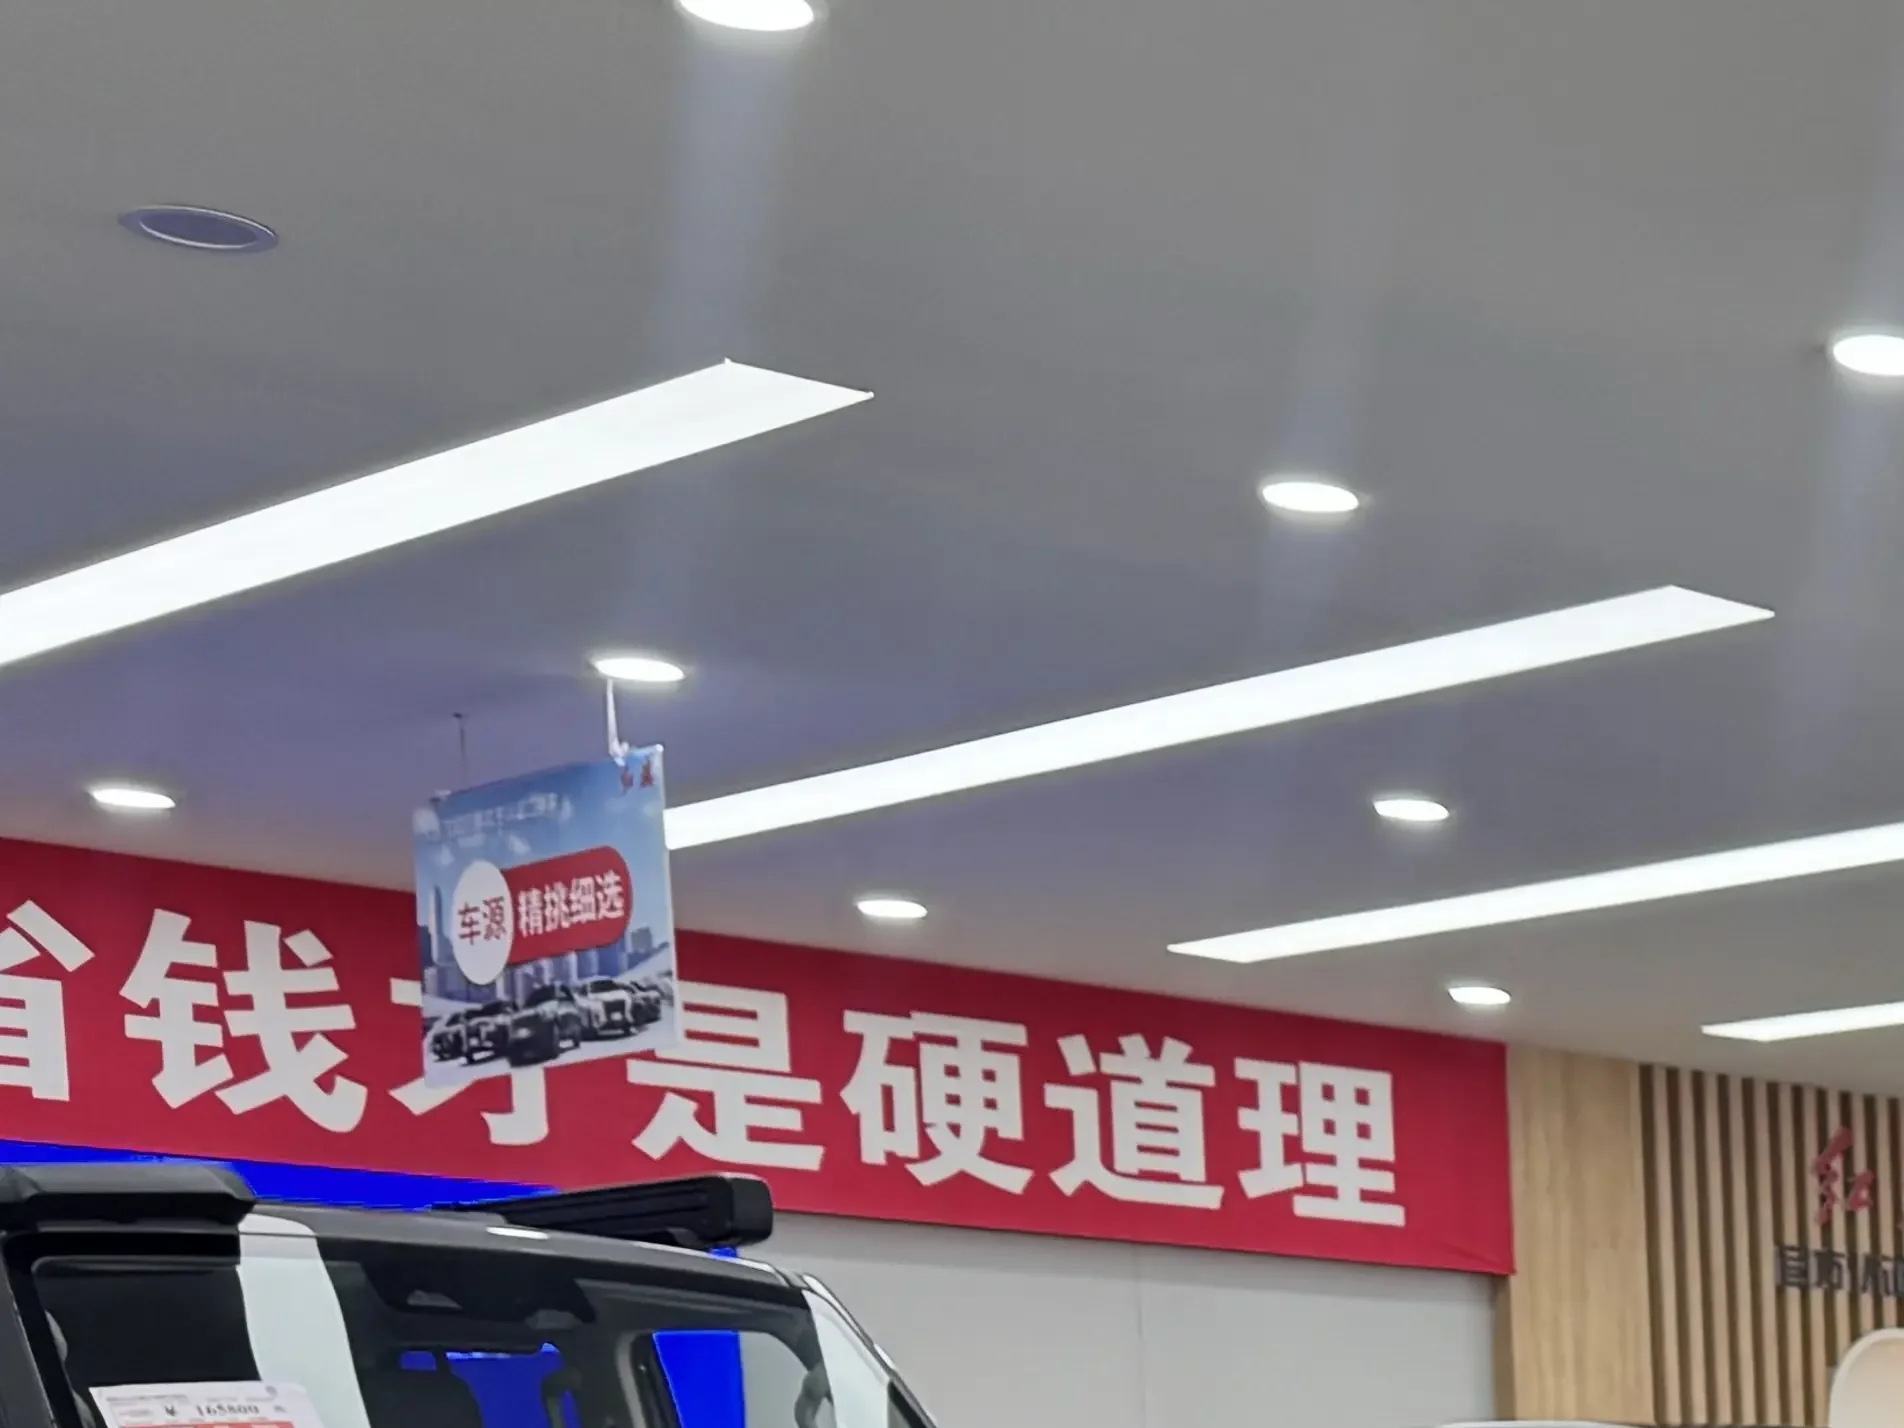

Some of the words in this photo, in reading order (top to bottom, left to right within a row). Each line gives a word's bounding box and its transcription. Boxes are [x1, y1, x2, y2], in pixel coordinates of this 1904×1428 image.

[457, 896, 507, 945] 车源
[518, 870, 625, 936] 精挑细选
